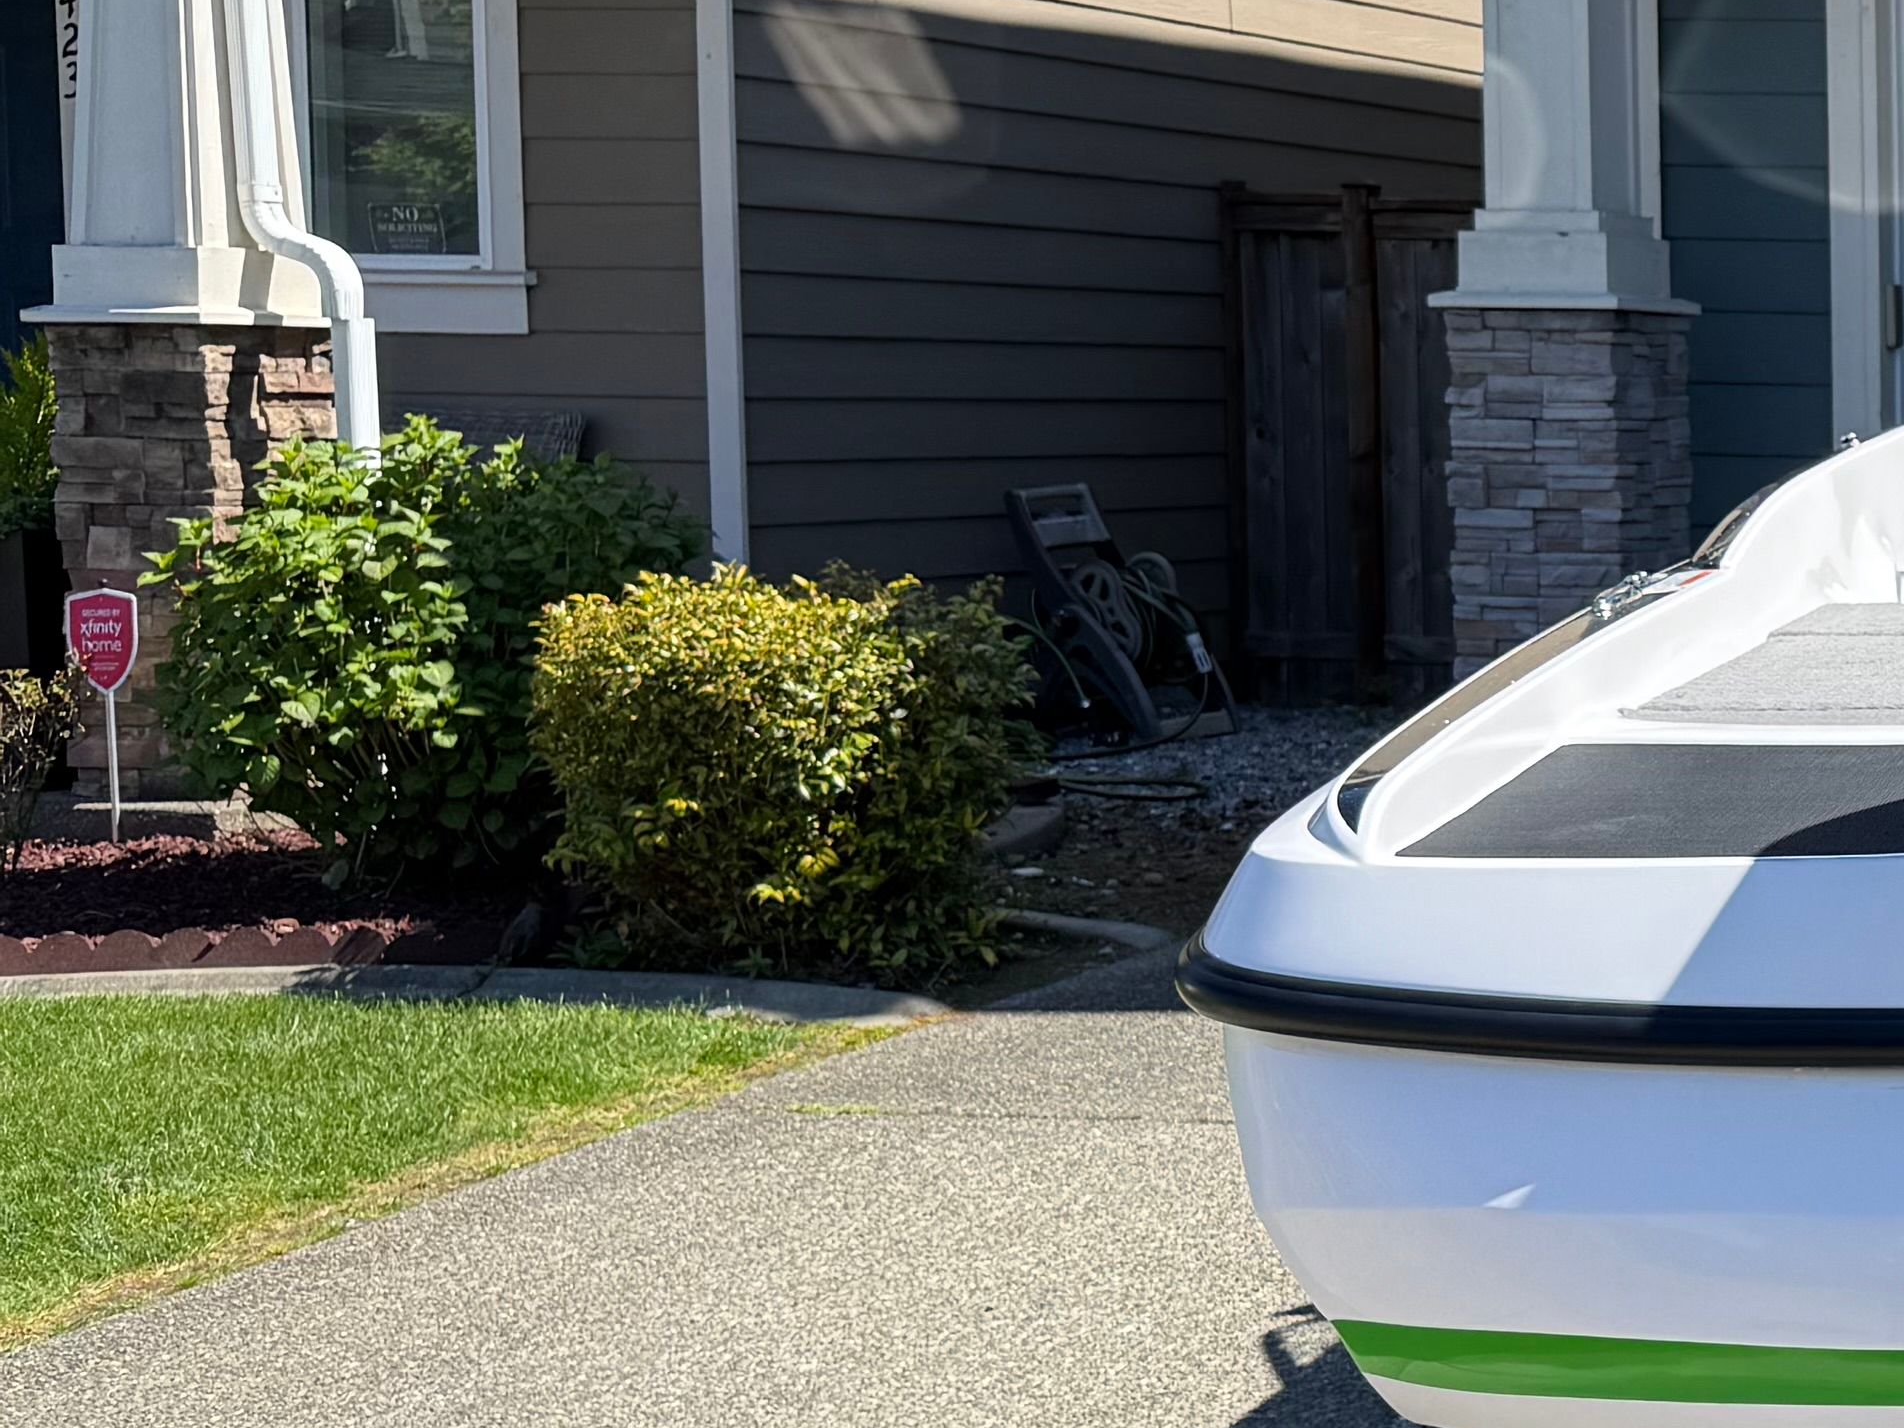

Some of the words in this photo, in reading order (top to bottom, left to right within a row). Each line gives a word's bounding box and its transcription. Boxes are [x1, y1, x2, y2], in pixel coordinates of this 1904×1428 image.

[392, 206, 419, 221] NO
[80, 618, 122, 637] xfinity
[82, 638, 122, 652] home
